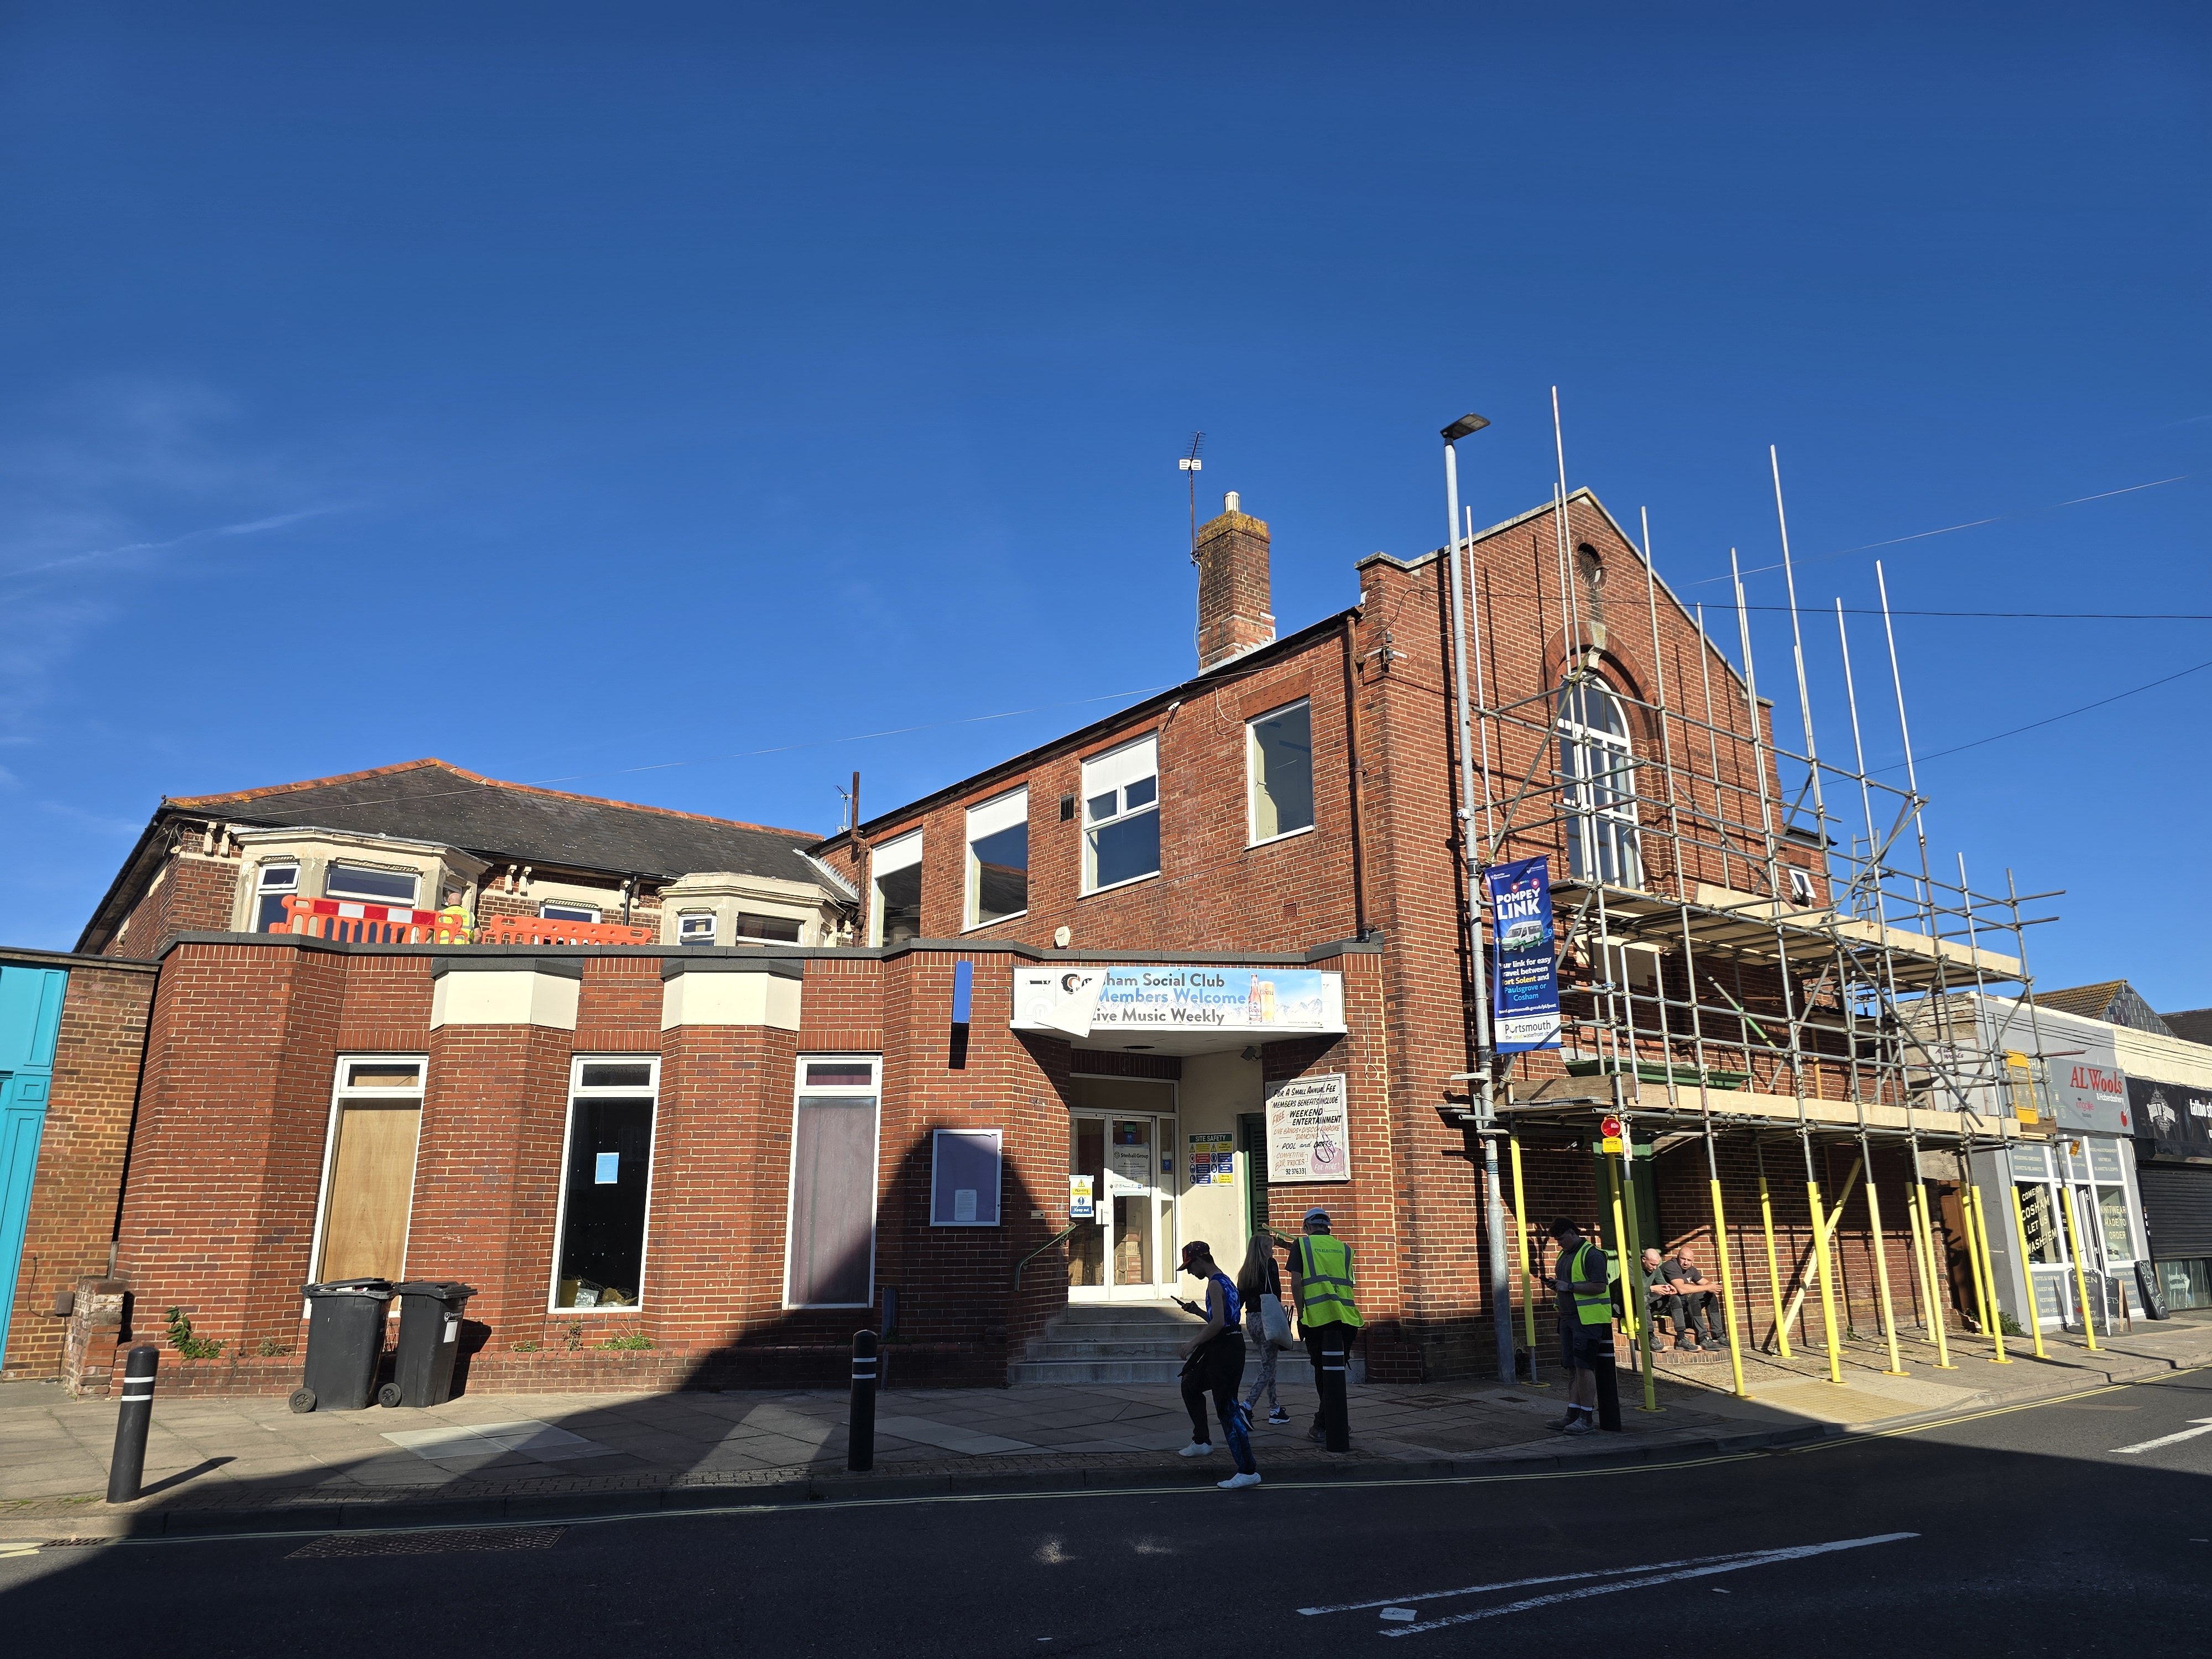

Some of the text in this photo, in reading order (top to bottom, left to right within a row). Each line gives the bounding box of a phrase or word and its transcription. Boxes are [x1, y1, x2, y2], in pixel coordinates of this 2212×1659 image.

[1496, 888, 1540, 904] POMPEY
[1497, 898, 1541, 920] LINK
[1520, 966, 1548, 974] between
[1103, 973, 1138, 986] ham
[1142, 973, 1185, 986] Social
[1190, 973, 1225, 987] Club
[1516, 976, 1536, 984] Solent
[1099, 988, 1246, 1004] Members Welcome
[1504, 985, 1538, 994] Paulsgrove
[1122, 1008, 1166, 1021] Music
[1170, 1008, 1224, 1026] Weekly
[1505, 1020, 1551, 1034] Portsmouth
[2070, 1066, 2122, 1094] AL Wools
[1274, 1083, 1337, 1098] FOR A SMALL ANNUAL FEE
[1272, 1096, 1338, 1108] MEMBERS BENEFITS INCLUDE
[2189, 1098, 2206, 1117] tattoo
[1272, 1110, 1285, 1125] FREE
[1290, 1108, 1323, 1118] WEEKEND
[1292, 1115, 1342, 1125] ENTERTAINMENT
[1275, 1161, 1286, 1171] BAR
[2022, 1184, 2043, 1201] COME ON
[2021, 1196, 2050, 1220] COSHAM
[2100, 1206, 2126, 1214] KNITWEAR
[2027, 1216, 2048, 1234] LET US
[2105, 1218, 2119, 1227] MADE
[2109, 1231, 2126, 1239] ORDER
